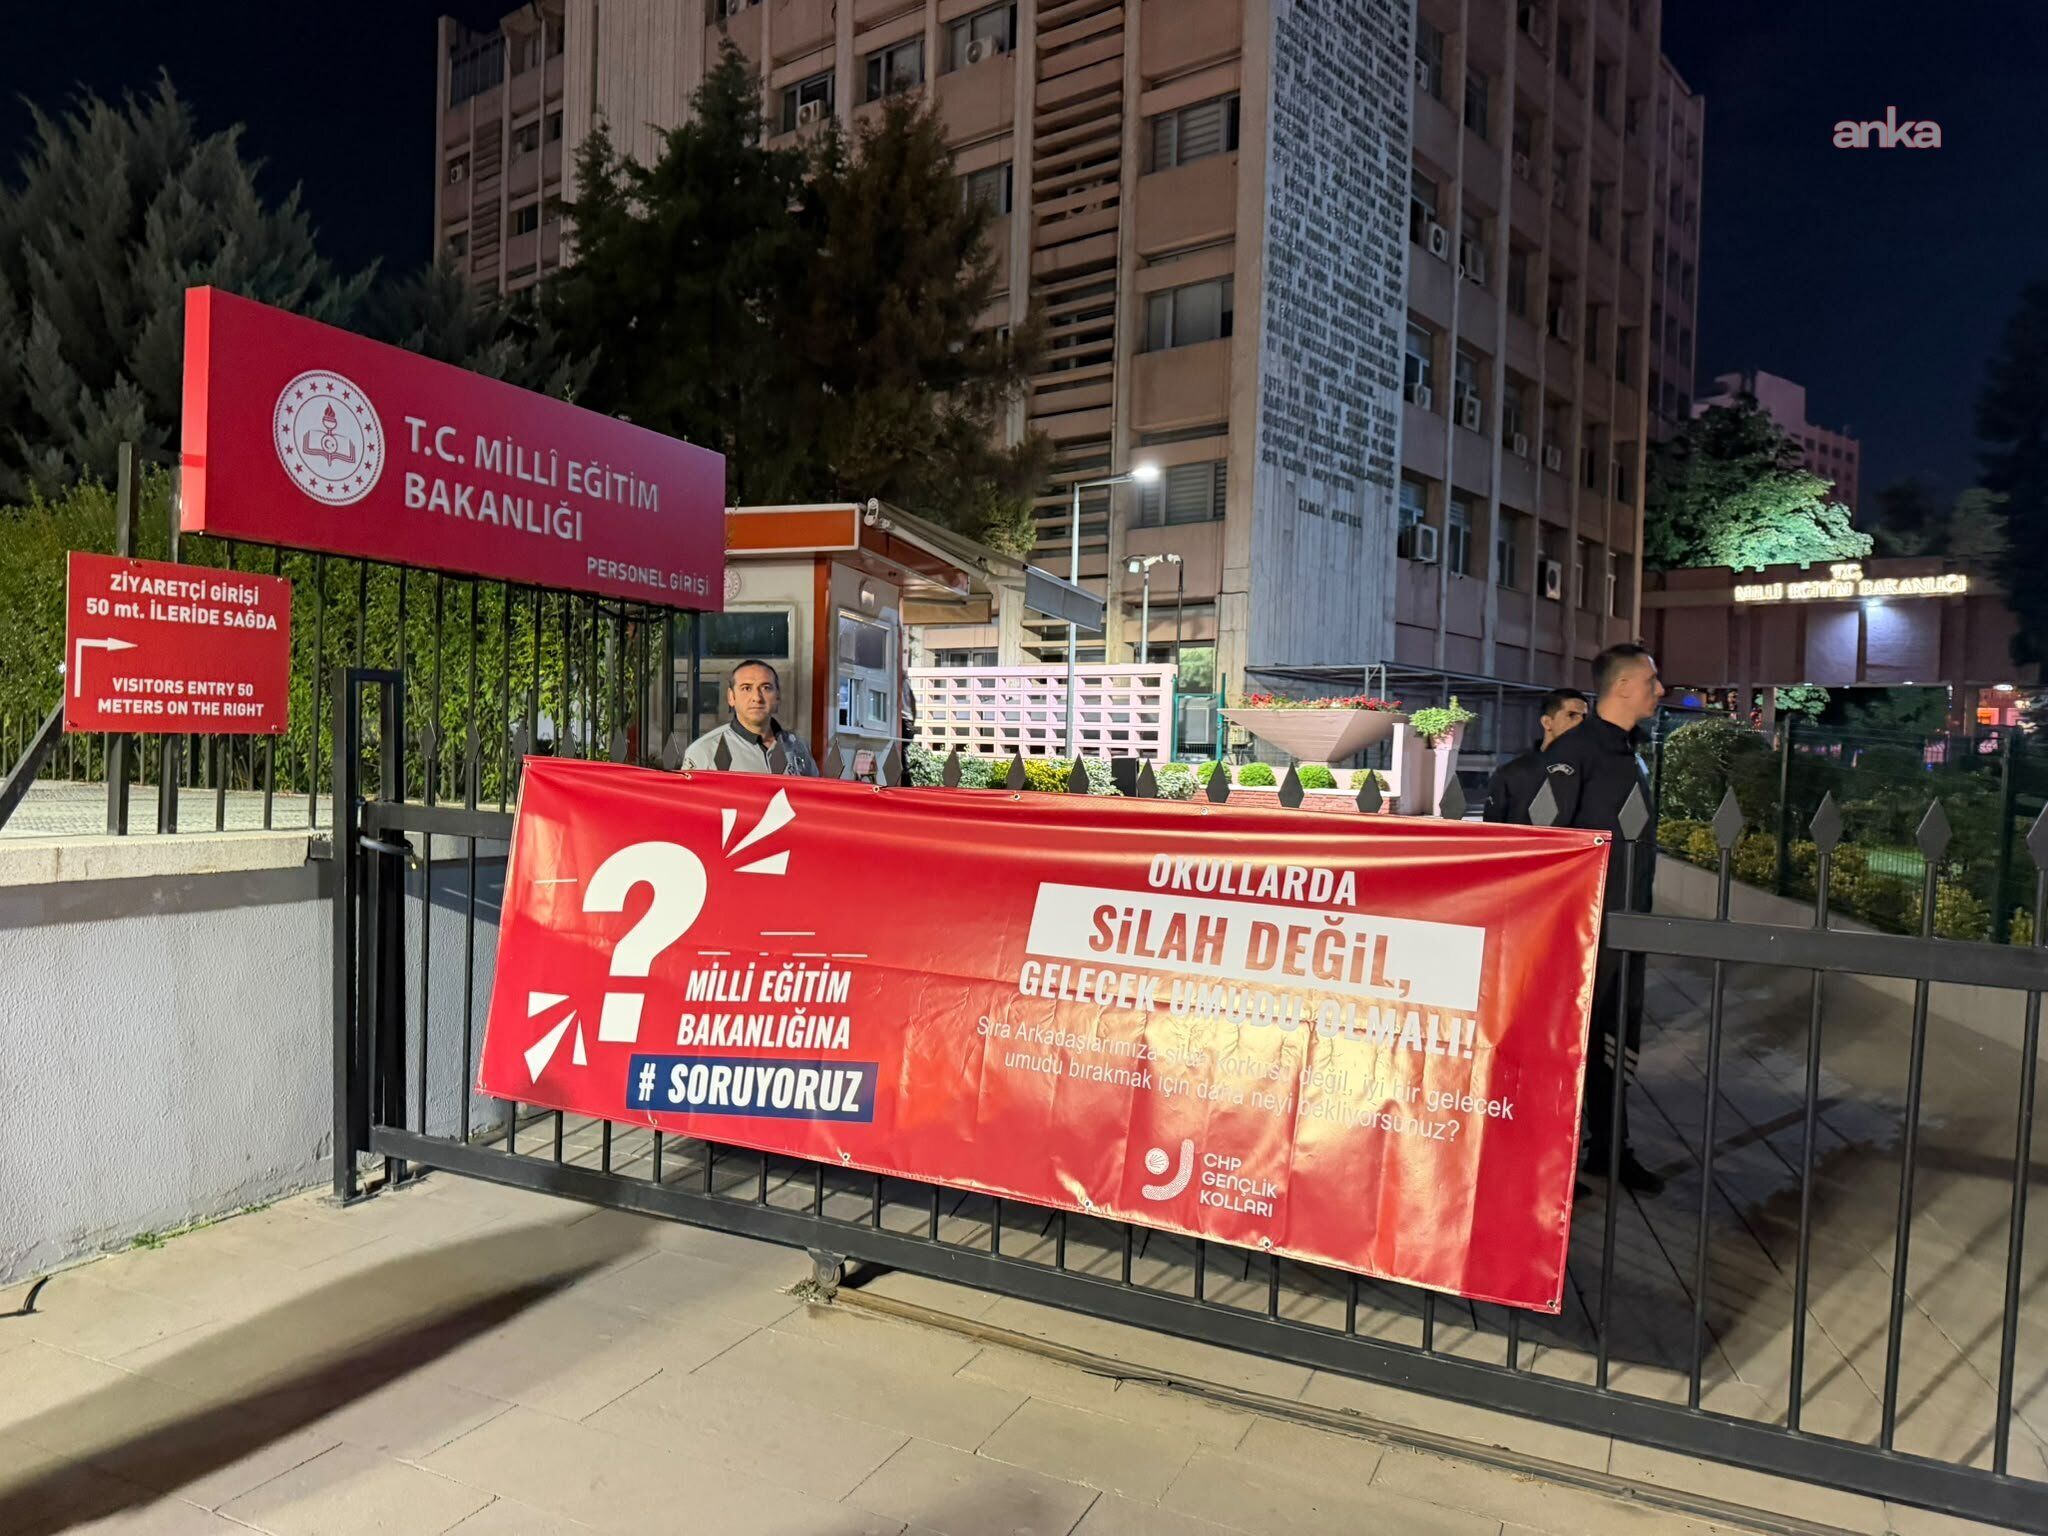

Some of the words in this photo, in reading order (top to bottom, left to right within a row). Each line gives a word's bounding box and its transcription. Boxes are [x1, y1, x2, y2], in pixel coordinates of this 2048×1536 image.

[405, 416, 464, 465] T.C.
[475, 435, 558, 487] MİLLÎ
[567, 460, 659, 512] EĞİTİM
[405, 472, 582, 541] BAKANLIĞI
[110, 571, 206, 600] ZİYARETÇİ
[210, 582, 259, 606] GİRİŞİ
[587, 556, 666, 588] PERSONEL
[670, 570, 709, 596] GİRİŞİ
[86, 597, 109, 616] 50
[114, 601, 145, 619] mt.
[150, 599, 220, 625] İLERİDE
[223, 610, 277, 631] SAĞDA
[98, 698, 164, 715] METERS
[167, 701, 188, 715] ON
[192, 702, 220, 716] THE
[223, 703, 264, 717] RIGHT
[112, 677, 184, 694] VISITORS
[187, 681, 235, 697] ENTRY
[237, 683, 254, 697] 50
[1148, 853, 1357, 906] OKULLARDA
[685, 962, 755, 1002] MİLLİ
[759, 963, 851, 1004] EĞİTİM
[676, 1007, 851, 1050] BAKANLIĞINA
[1018, 960, 1160, 1012] GELECEK
[1170, 978, 1304, 1032] UMUDU
[1317, 999, 1476, 1060] OLMALI!
[976, 1015, 1011, 1039] Sıra
[1014, 1021, 1157, 1061] Arkadaşlarımıza
[1300, 1065, 1353, 1096] değil,
[1426, 1089, 1514, 1120] gelecek
[1004, 1050, 1062, 1075] umudu
[1069, 1059, 1152, 1089] bırakmak
[1158, 1077, 1190, 1098] için
[1250, 1091, 1293, 1117] neyi
[1300, 1098, 1460, 1142] bekliyorsunuz?
[1203, 1153, 1242, 1171] CHP
[1200, 1190, 1273, 1218] KOLLARI
[1201, 1171, 1279, 1199] GENÇLİK
